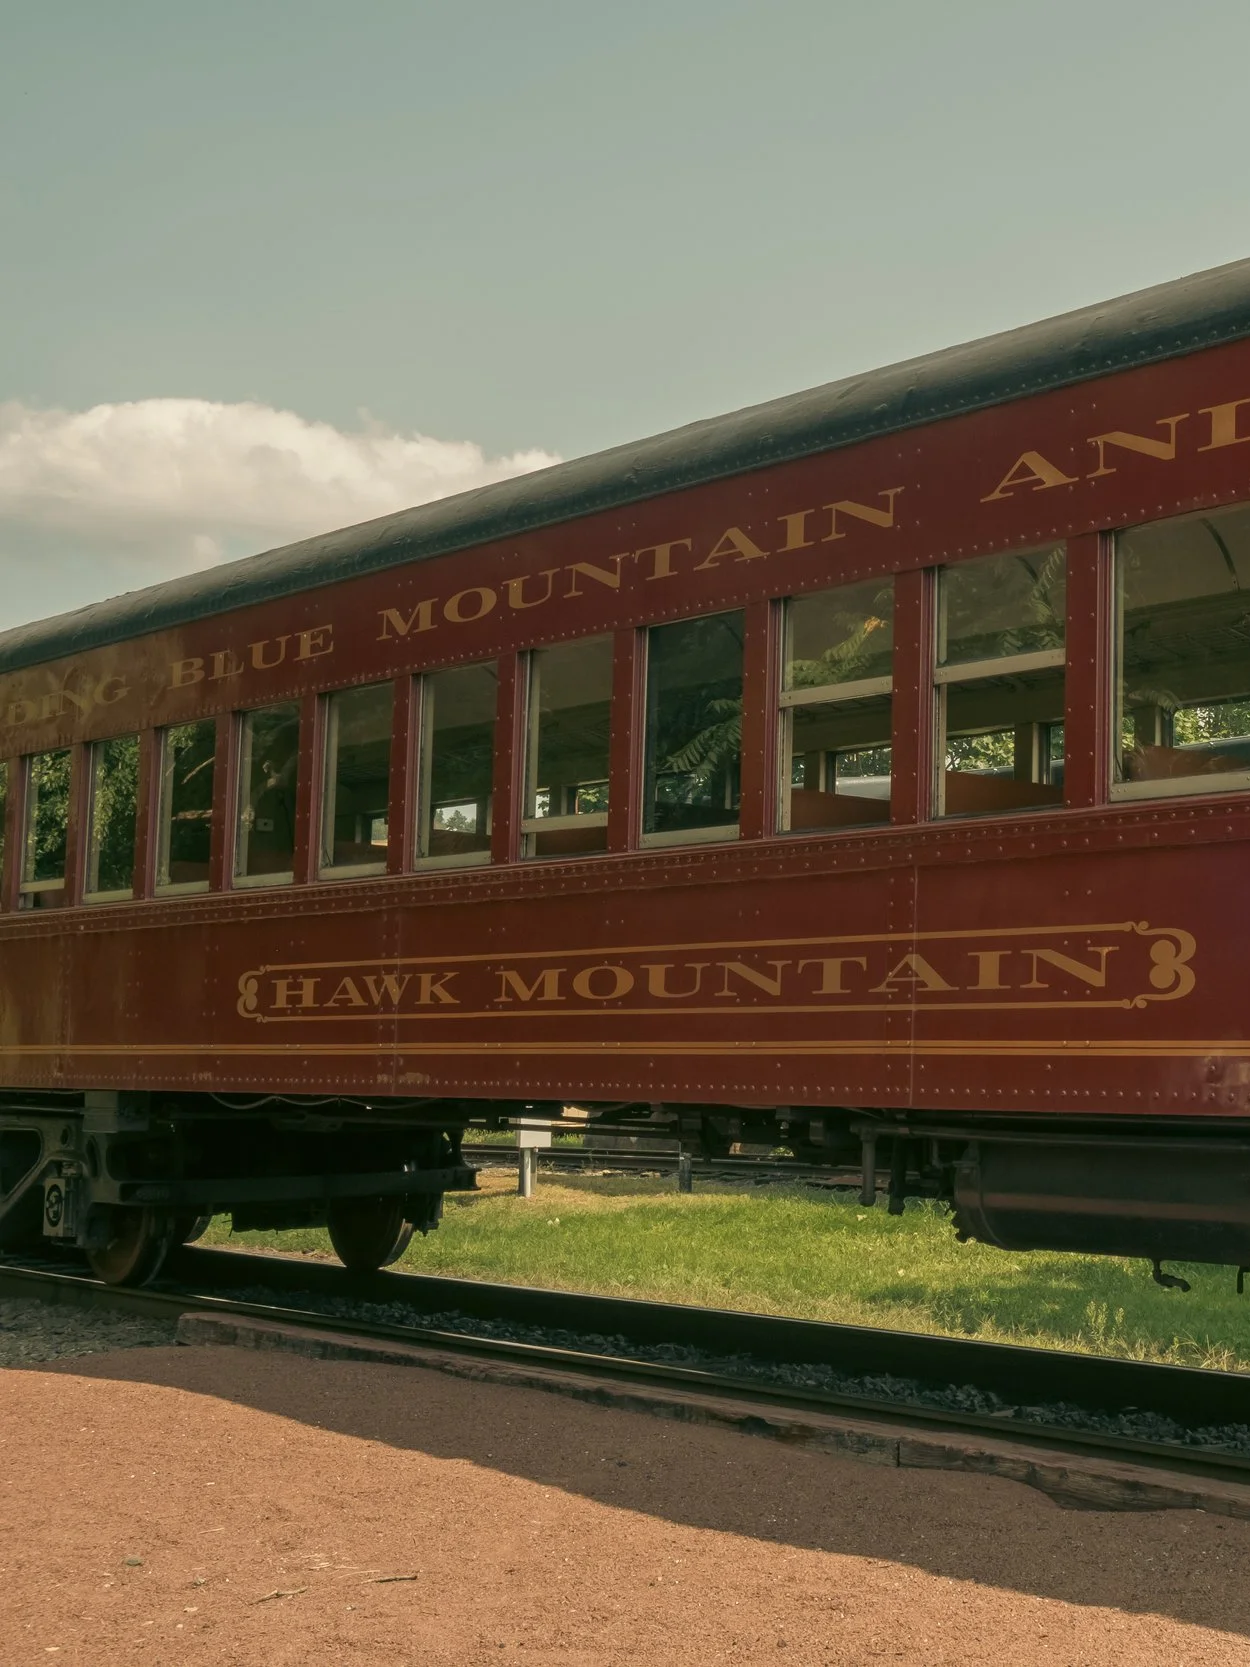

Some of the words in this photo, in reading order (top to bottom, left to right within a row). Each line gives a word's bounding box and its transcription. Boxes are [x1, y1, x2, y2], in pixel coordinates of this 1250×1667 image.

[167, 624, 334, 690] BLUE
[376, 487, 905, 641] MOUNTAIN
[274, 971, 462, 1008] HAWK
[496, 944, 1119, 1004] MOUNTAIN
